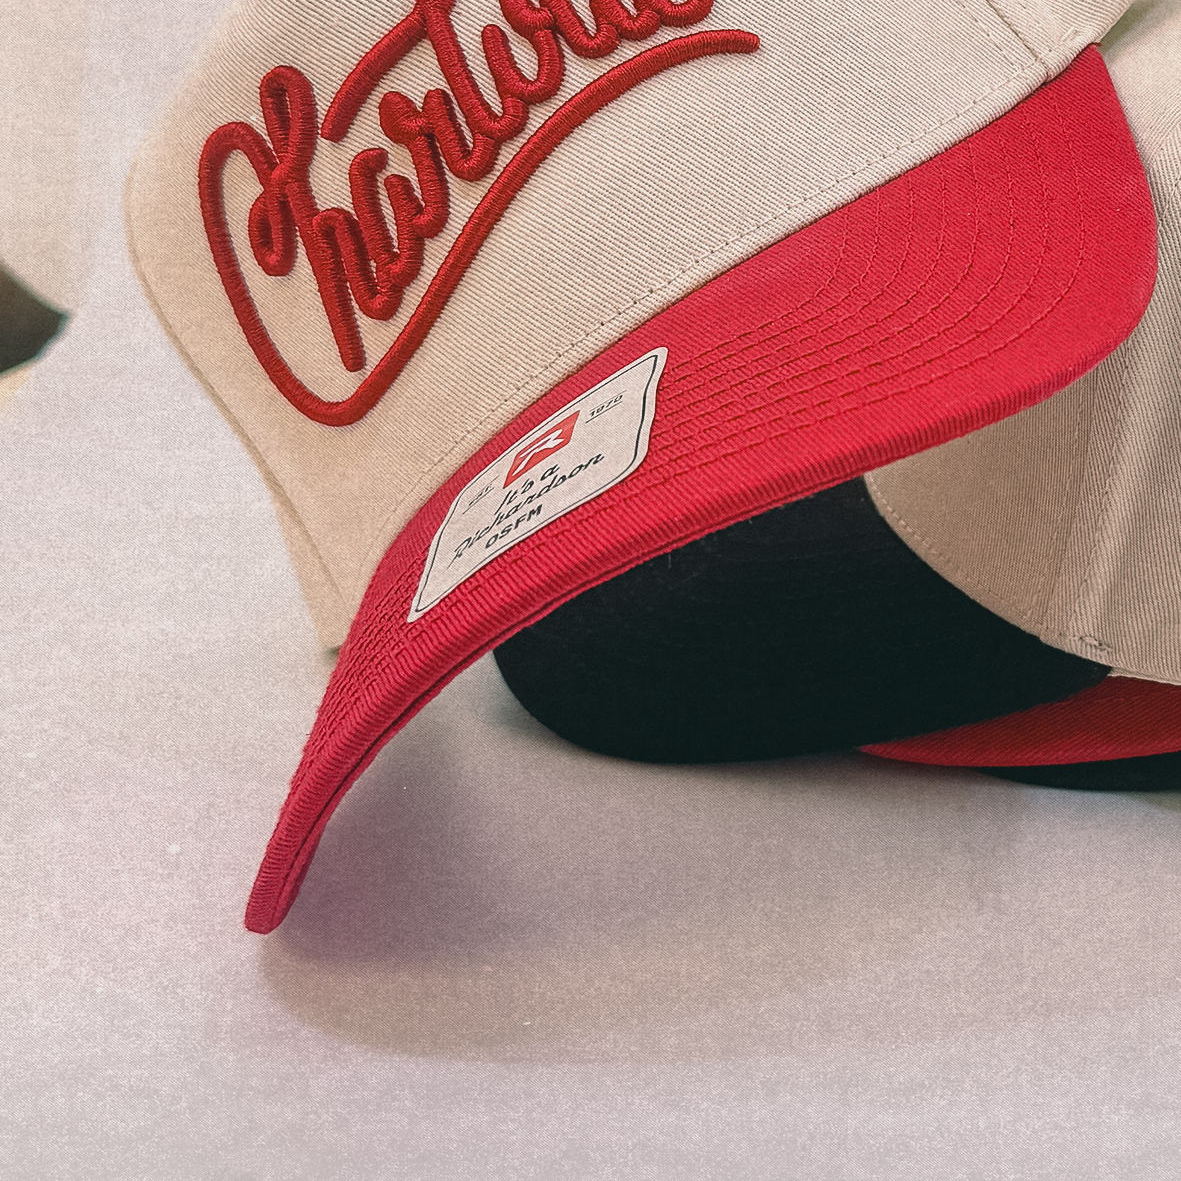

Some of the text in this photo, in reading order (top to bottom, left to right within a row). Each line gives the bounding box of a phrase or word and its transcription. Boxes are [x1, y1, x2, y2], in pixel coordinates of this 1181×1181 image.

[540, 463, 561, 482] a
[447, 453, 605, 569] Richardson
[485, 503, 543, 549] OSFM
